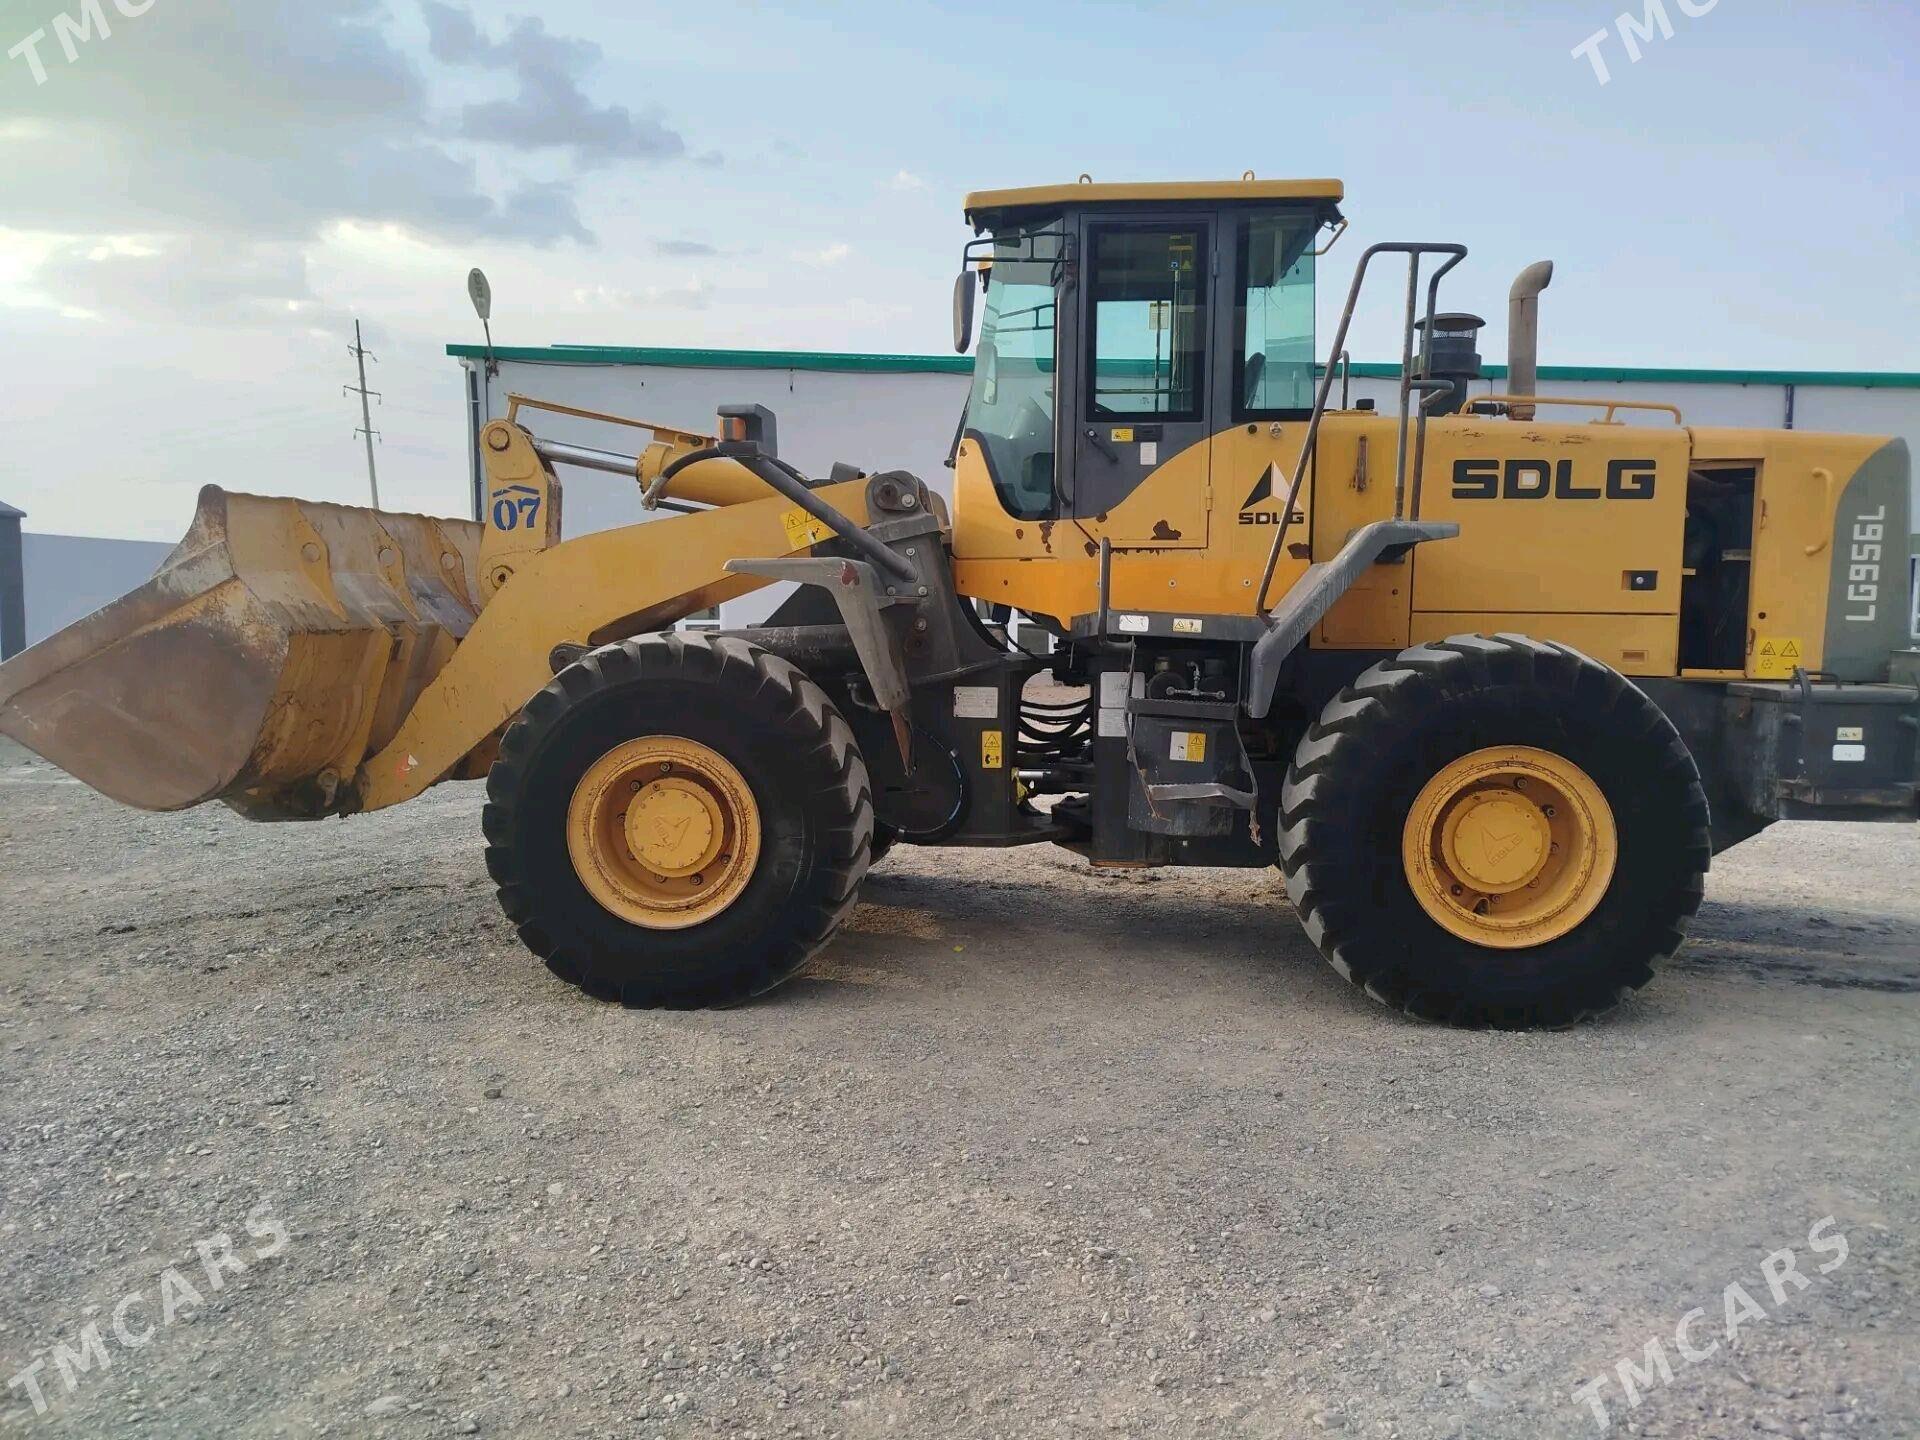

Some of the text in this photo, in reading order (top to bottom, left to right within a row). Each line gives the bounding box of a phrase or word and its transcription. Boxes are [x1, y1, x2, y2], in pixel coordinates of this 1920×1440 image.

[1452, 460, 1656, 499] SDLG
[493, 497, 541, 531] 07
[1845, 505, 1885, 621] LG956L
